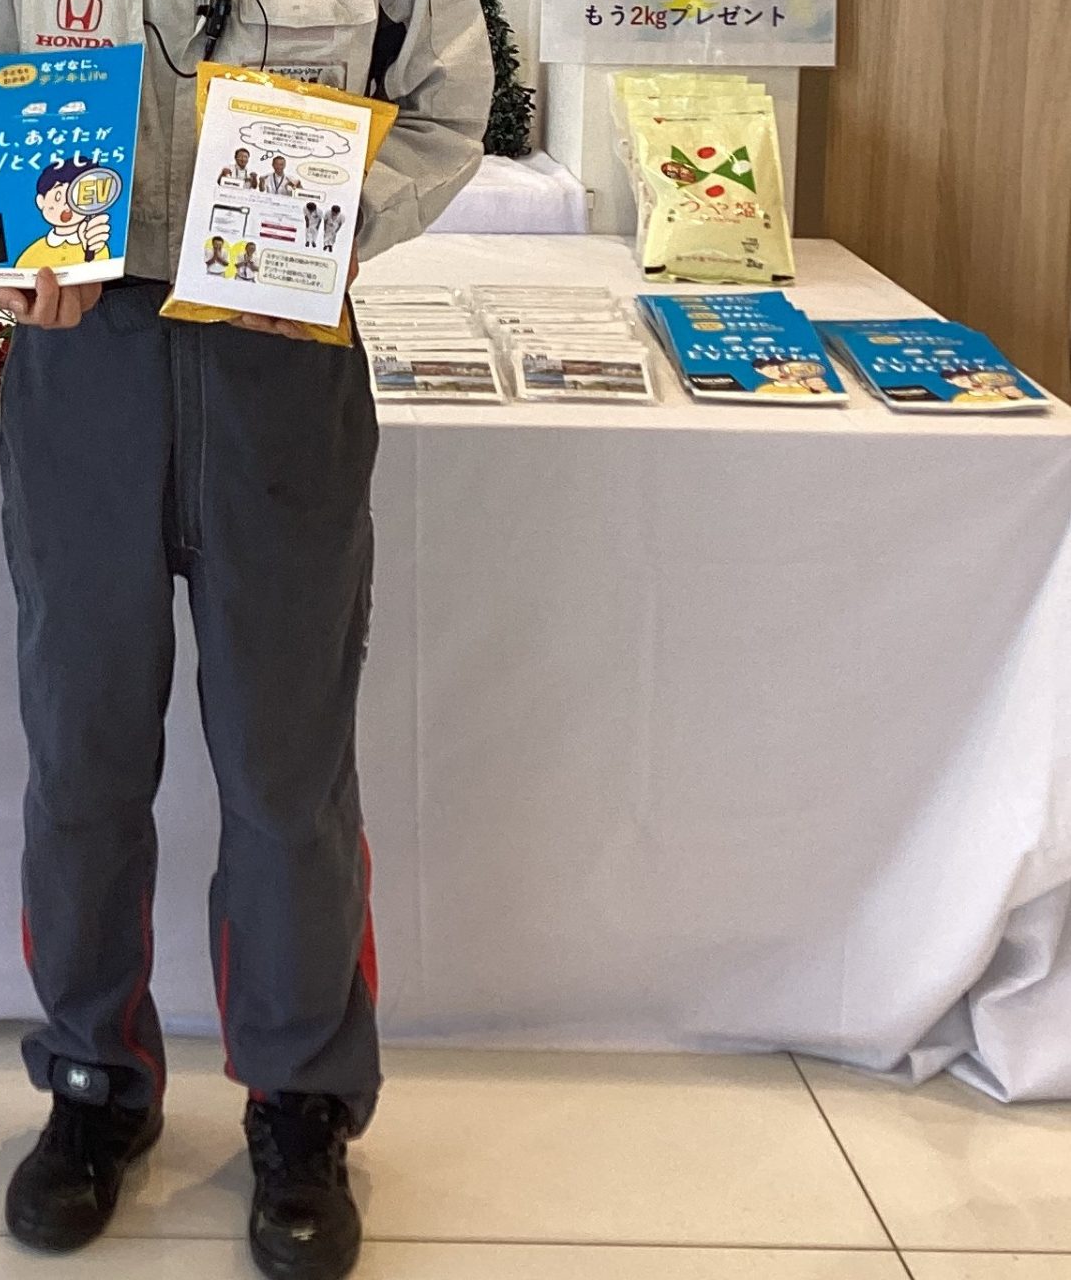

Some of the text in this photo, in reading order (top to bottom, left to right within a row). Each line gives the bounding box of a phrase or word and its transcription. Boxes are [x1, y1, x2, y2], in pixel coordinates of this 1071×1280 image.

[585, 4, 785, 29] もう2kgプレゼント
[36, 34, 114, 49] HONDA
[76, 175, 115, 206] EV
